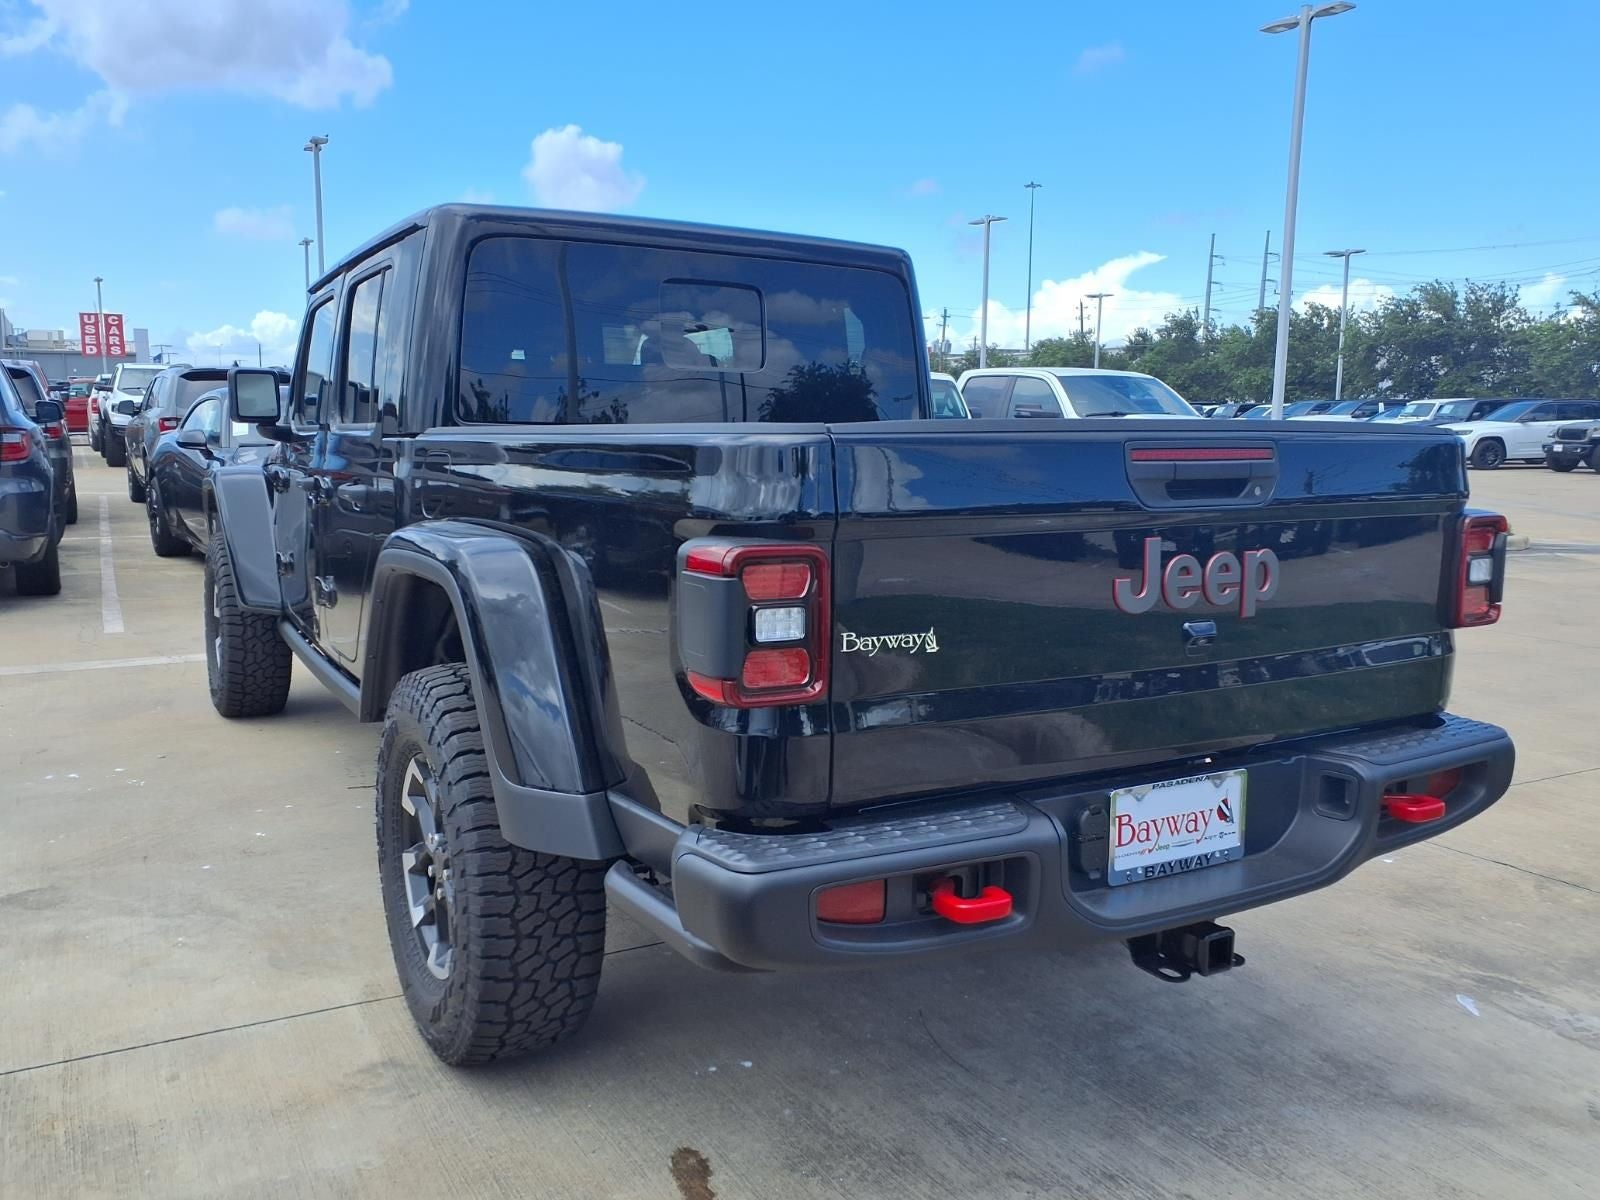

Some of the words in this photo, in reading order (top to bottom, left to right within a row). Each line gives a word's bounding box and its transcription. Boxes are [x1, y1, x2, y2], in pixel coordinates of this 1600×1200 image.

[83, 314, 98, 355] USED
[107, 315, 122, 355] CARS
[1112, 536, 1279, 618] Jeep
[840, 632, 926, 657] Bayway
[1152, 775, 1210, 790] PASADENA
[1115, 808, 1214, 854] Bayway
[1144, 854, 1214, 879] BAYWAY
